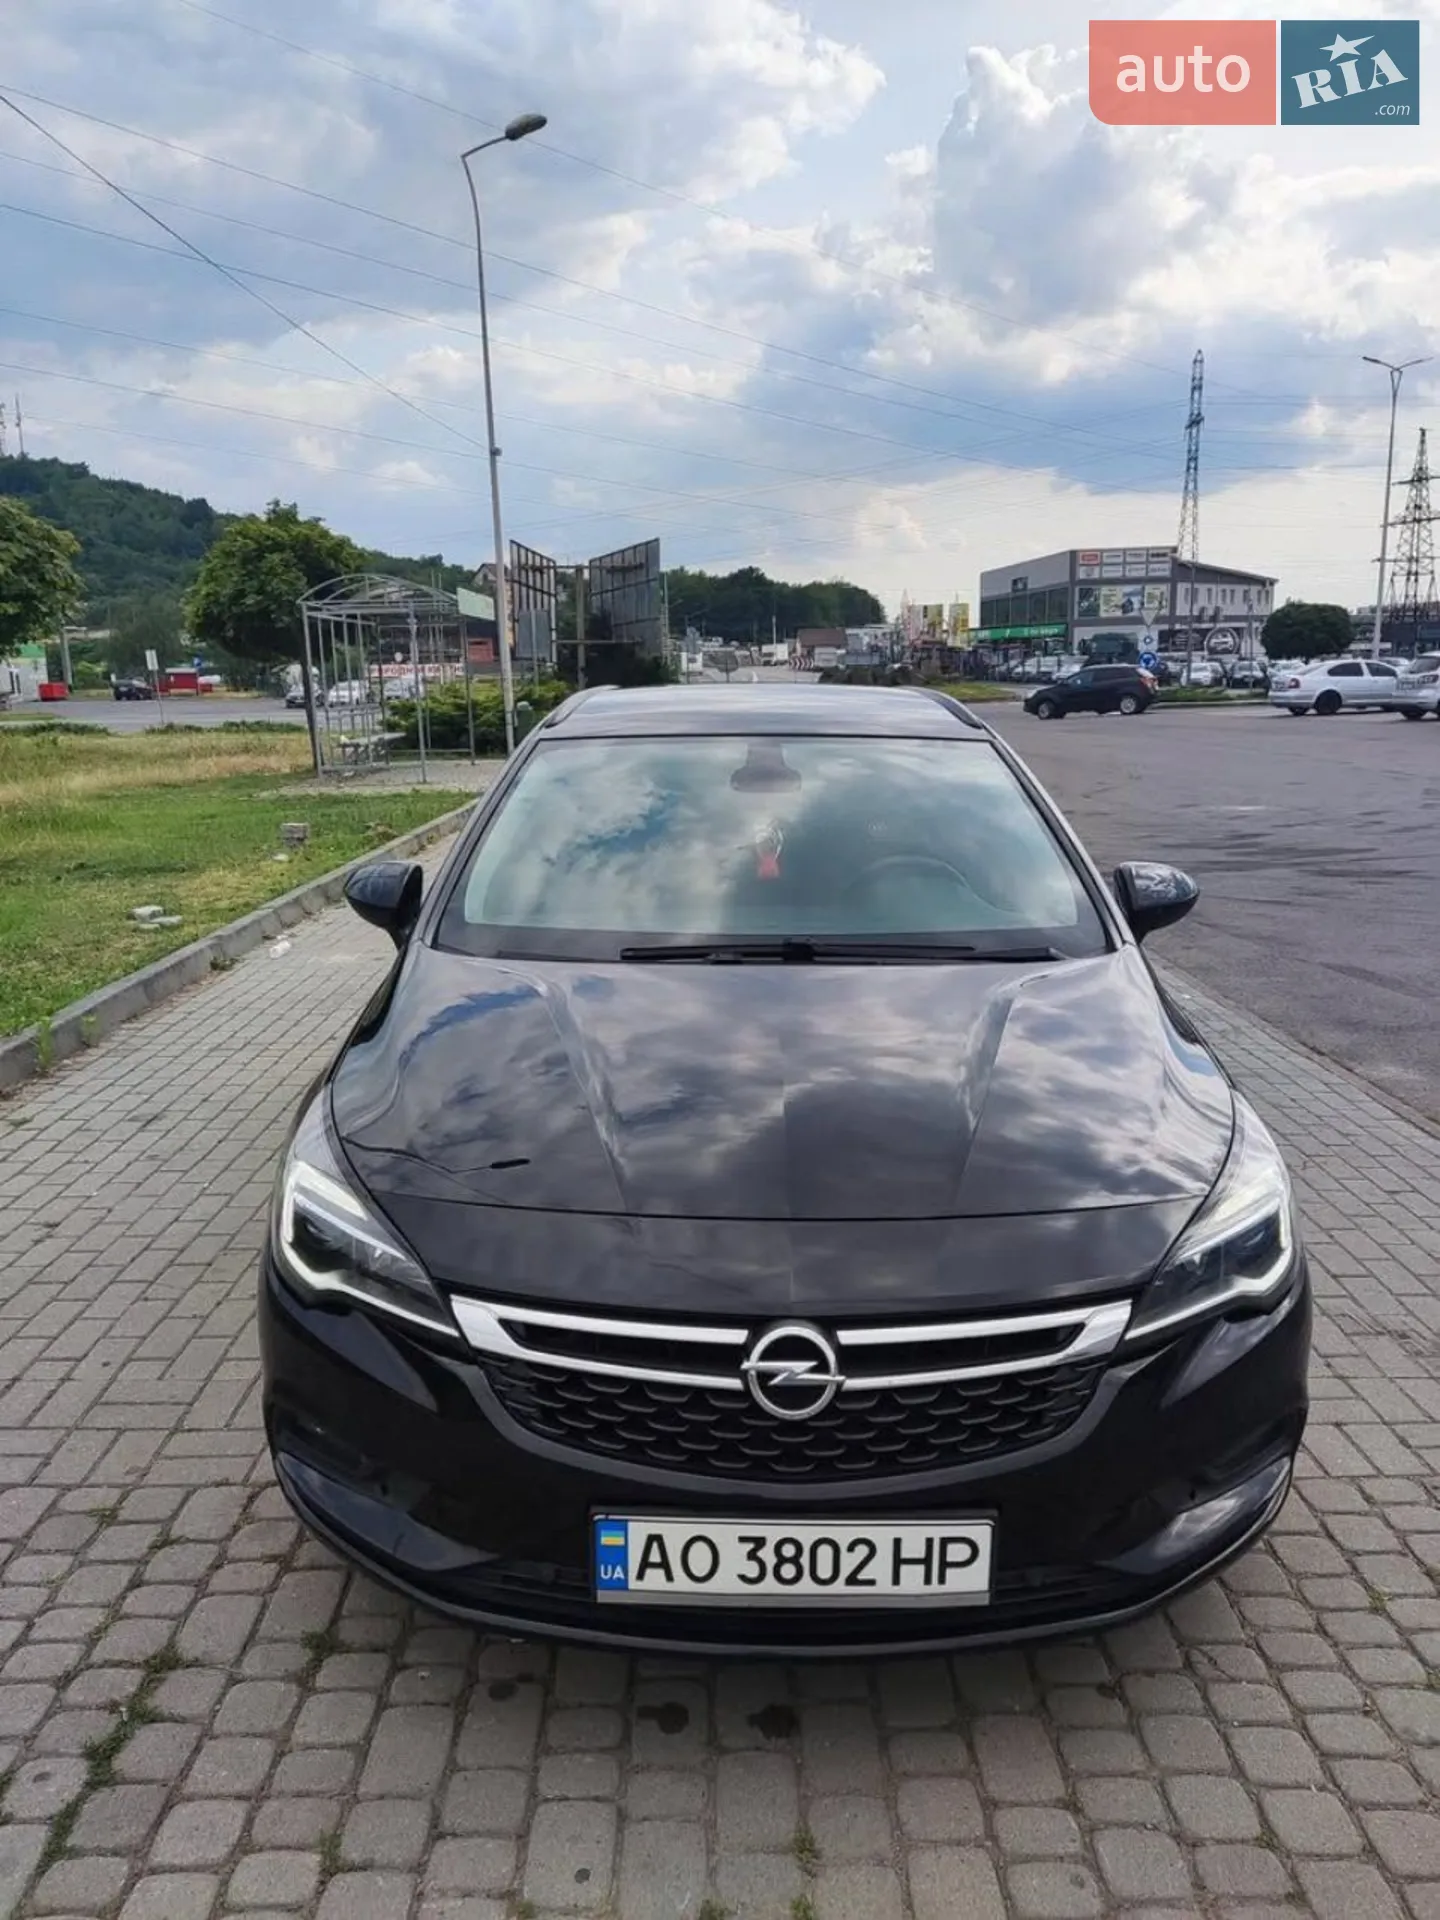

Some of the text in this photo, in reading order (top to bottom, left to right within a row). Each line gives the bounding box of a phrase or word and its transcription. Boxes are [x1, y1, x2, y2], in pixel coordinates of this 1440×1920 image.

[601, 1564, 625, 1580] UA
[635, 1533, 980, 1587] AO 3802 HP
